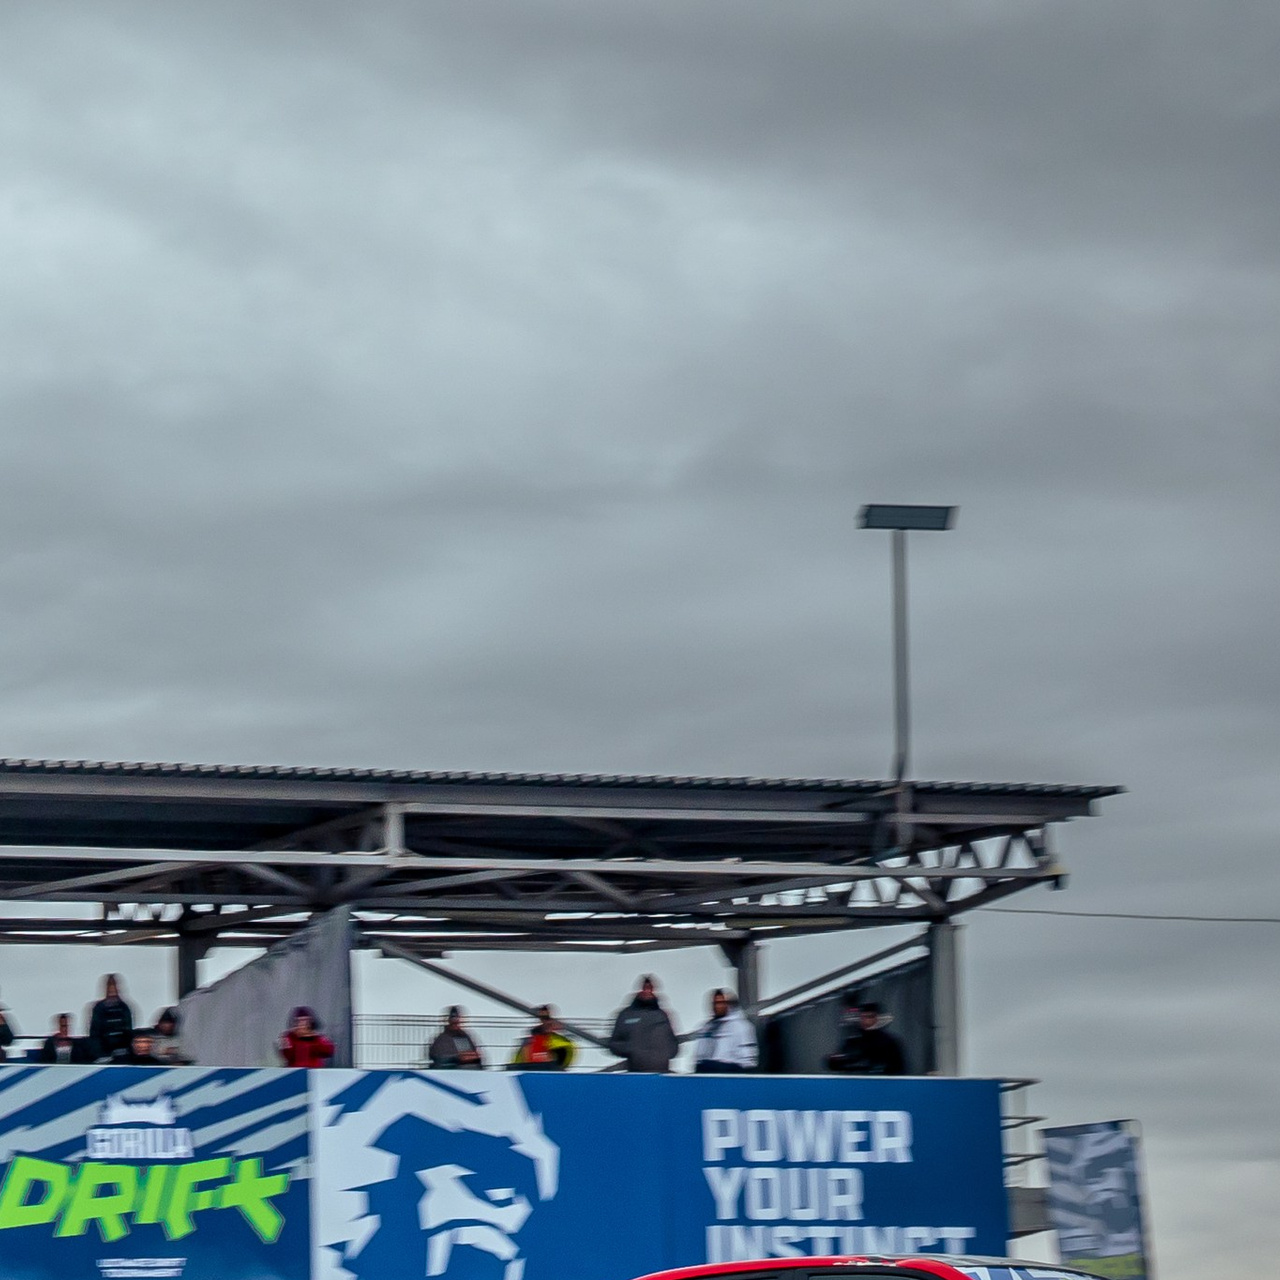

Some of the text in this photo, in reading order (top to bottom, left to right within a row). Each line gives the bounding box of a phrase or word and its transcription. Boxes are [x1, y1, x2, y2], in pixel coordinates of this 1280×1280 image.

[702, 1108, 914, 1163] POWER
[702, 1166, 865, 1221] YOUR
[705, 1225, 977, 1263] INSTINCT
